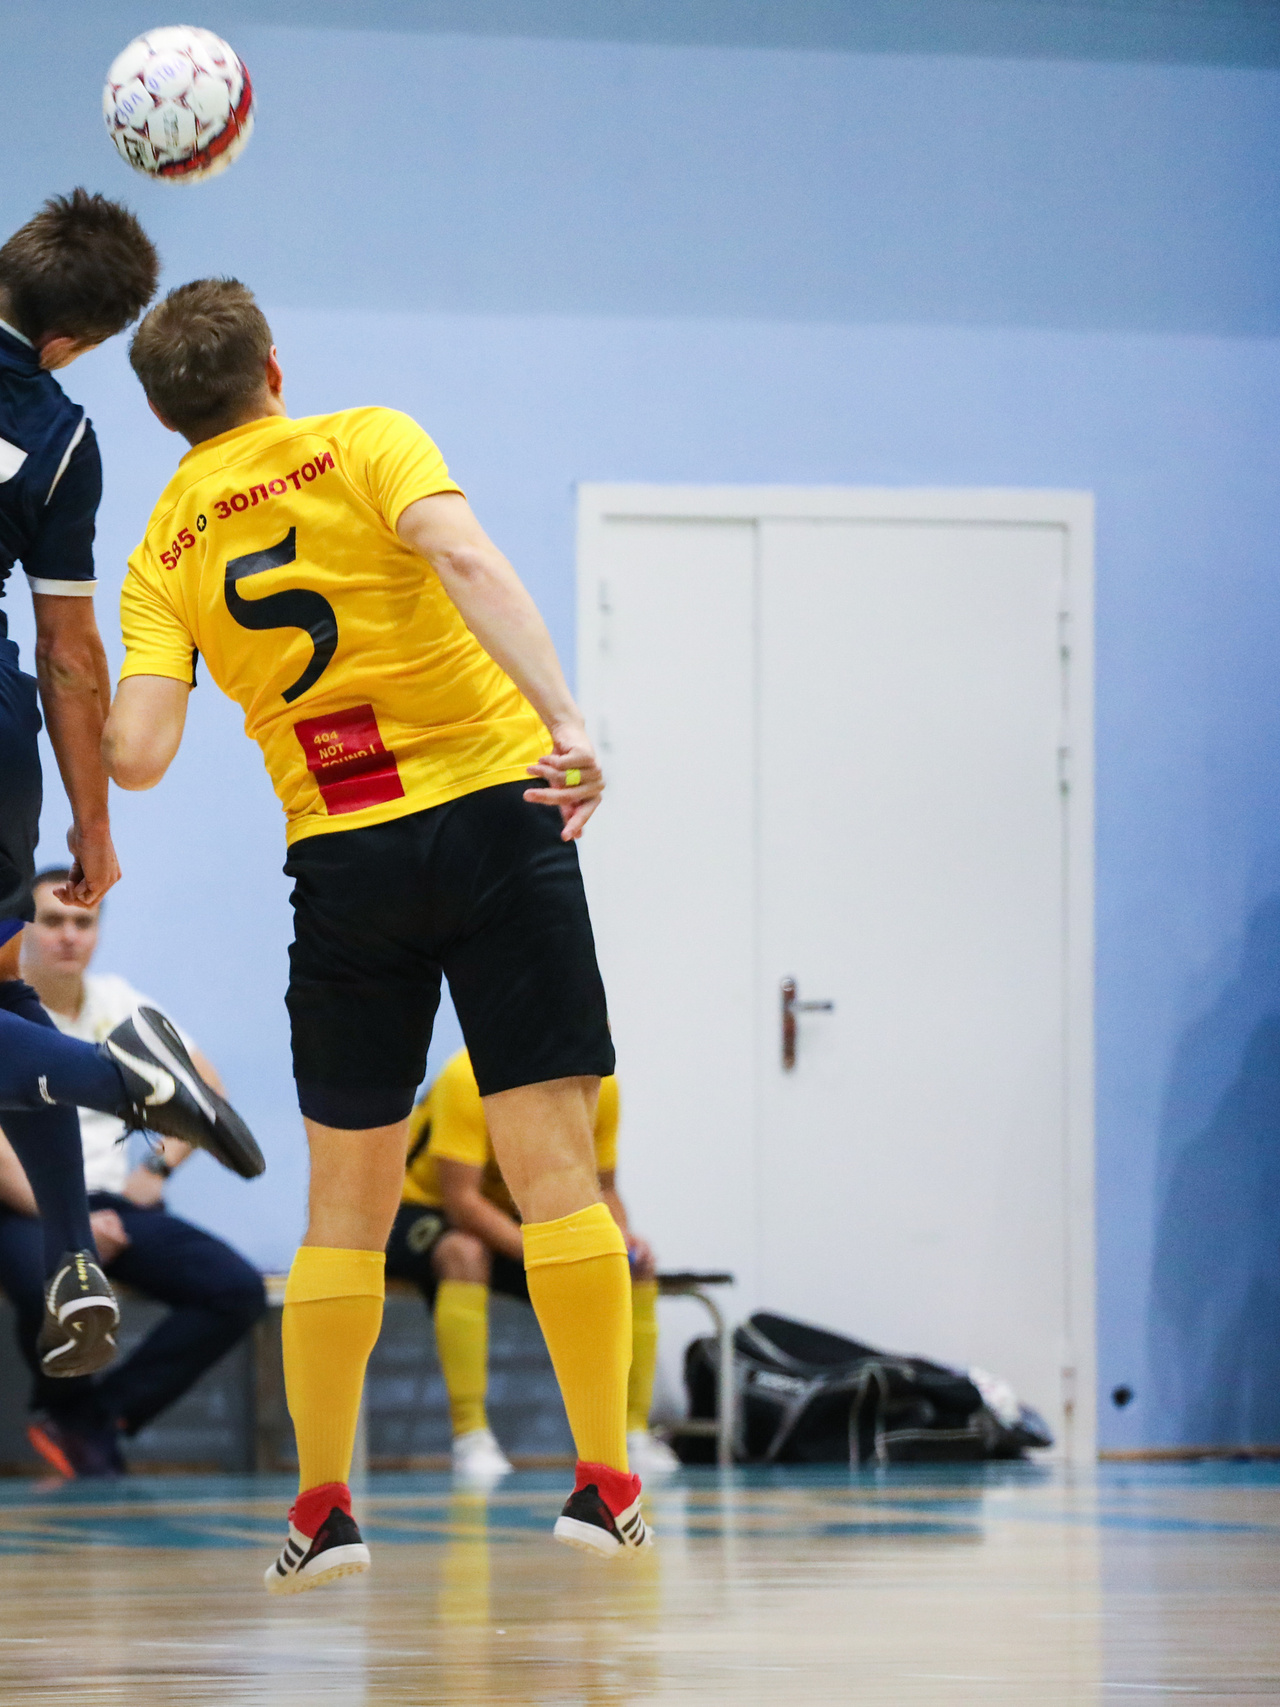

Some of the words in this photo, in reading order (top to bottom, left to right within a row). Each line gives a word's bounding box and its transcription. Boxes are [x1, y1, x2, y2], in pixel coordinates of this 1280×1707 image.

[160, 528, 196, 571] 585
[213, 452, 336, 519] ЗОЛОТОЙ
[224, 526, 339, 704] 5
[313, 730, 338, 745] 404
[318, 742, 344, 760] NOT
